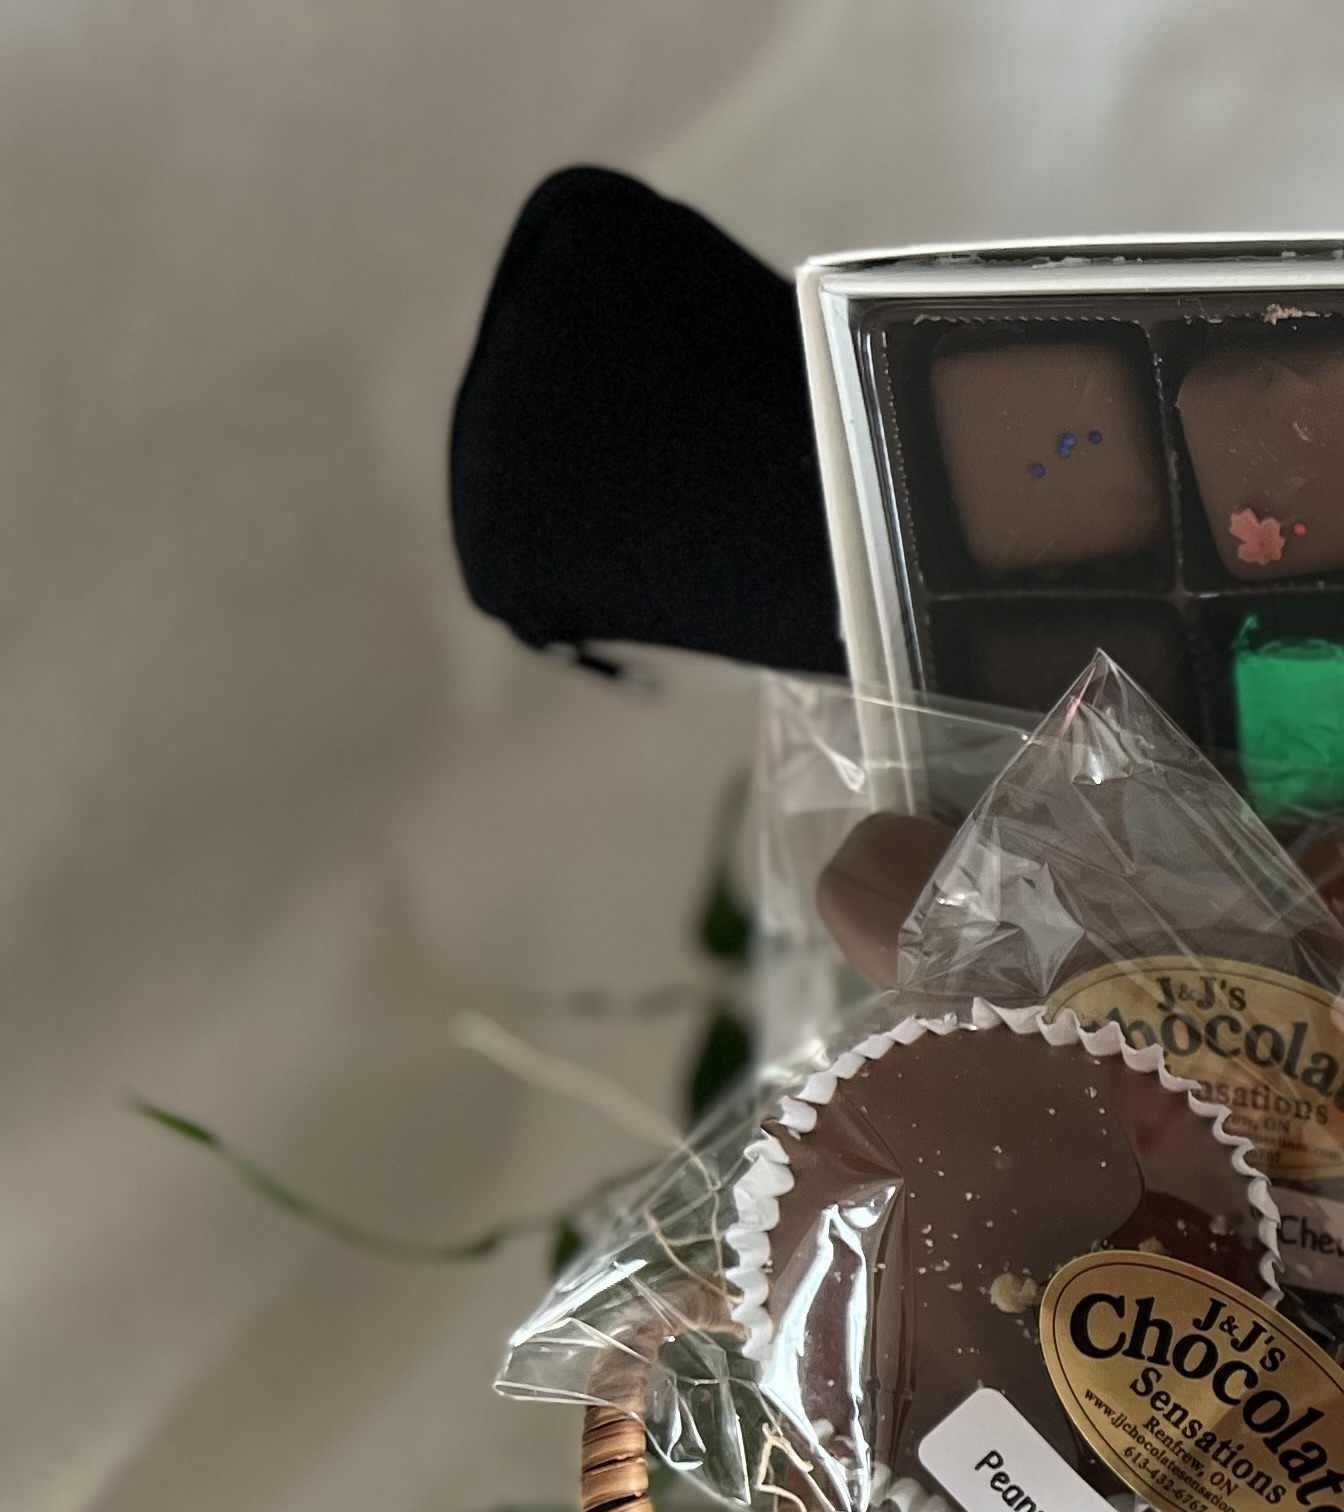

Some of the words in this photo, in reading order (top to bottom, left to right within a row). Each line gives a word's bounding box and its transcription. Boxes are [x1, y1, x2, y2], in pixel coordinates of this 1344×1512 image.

[1194, 1296, 1287, 1374] J&J's
[1129, 1366, 1287, 1506] Sensations
[1142, 1415, 1206, 1478] Renfrew,
[1210, 1467, 1240, 1497] ON
